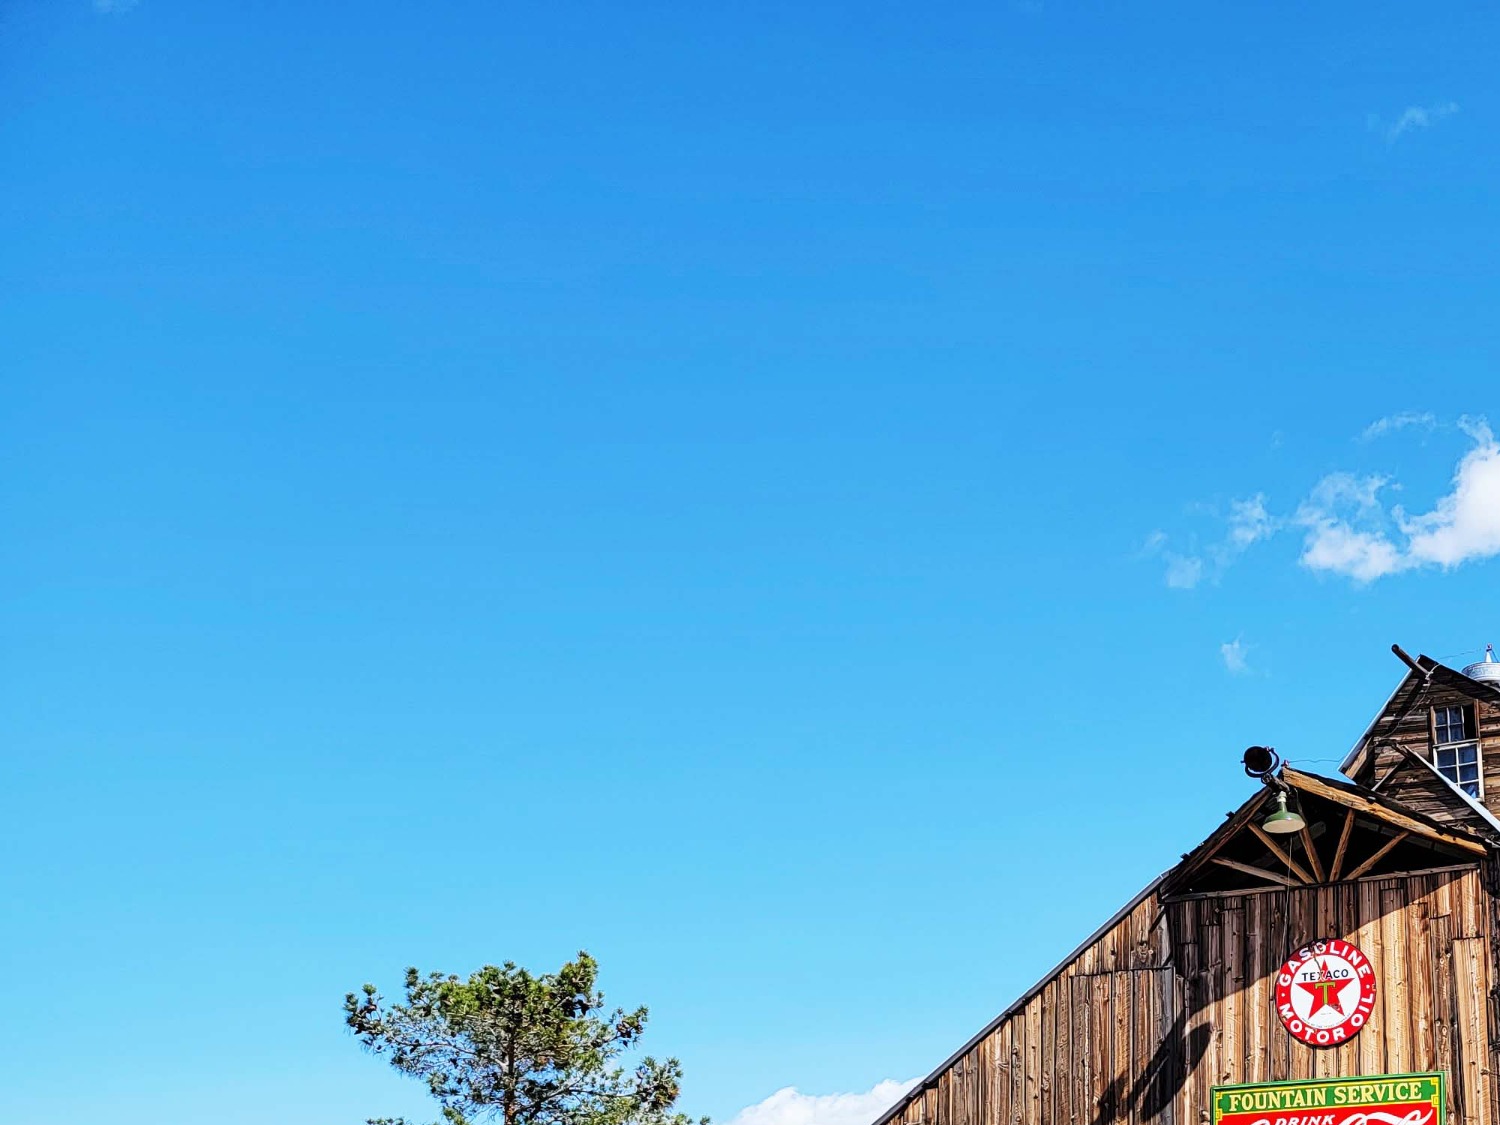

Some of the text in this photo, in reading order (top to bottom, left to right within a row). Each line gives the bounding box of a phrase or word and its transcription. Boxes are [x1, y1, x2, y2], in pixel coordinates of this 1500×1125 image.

[1279, 941, 1371, 987] GASOLINE
[1301, 968, 1349, 982] TEXACO
[1279, 993, 1374, 1043] MOTOR OIL
[1228, 1081, 1423, 1112] FOUNTAIN SERVICE
